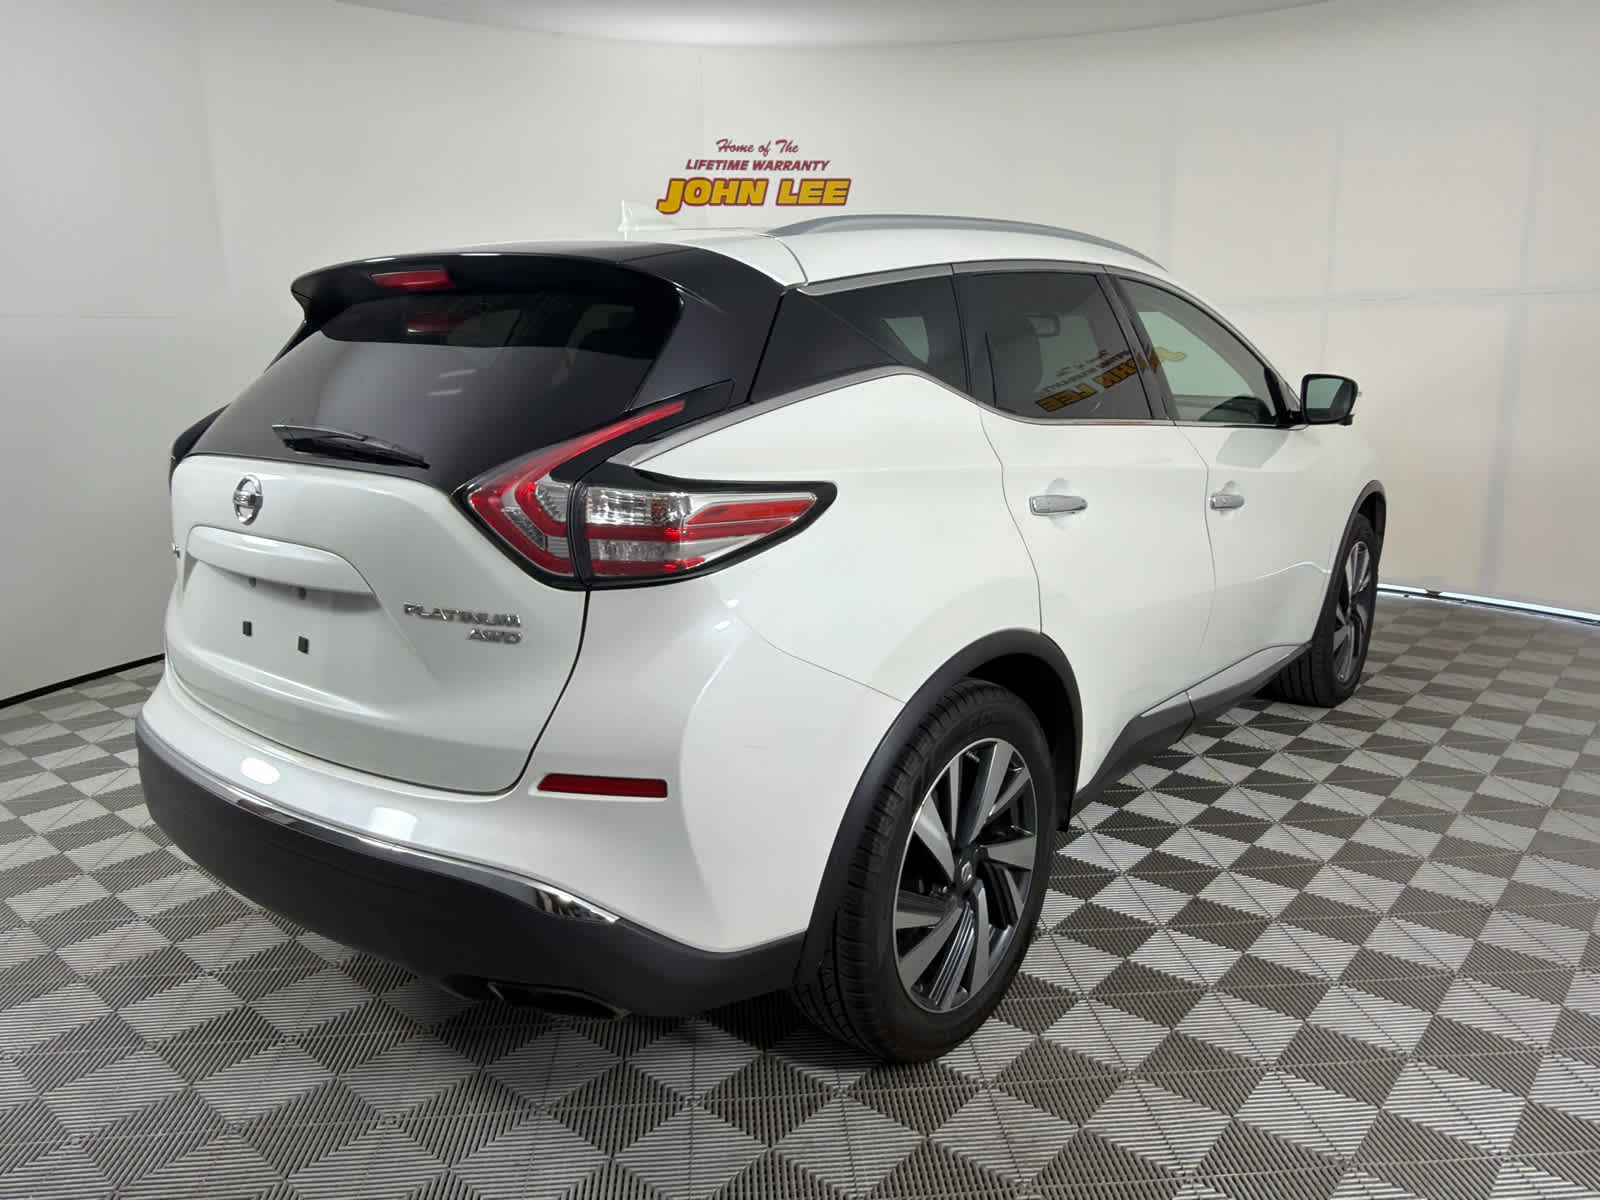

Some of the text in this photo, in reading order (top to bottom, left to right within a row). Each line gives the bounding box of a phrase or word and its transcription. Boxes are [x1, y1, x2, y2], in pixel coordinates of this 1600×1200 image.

[715, 138, 799, 157] Home of The
[685, 159, 830, 171] LIFETIME WARRANTY
[655, 177, 851, 214] JOHN LEE
[403, 601, 521, 627] PLATINUM
[468, 629, 521, 645] AWD
